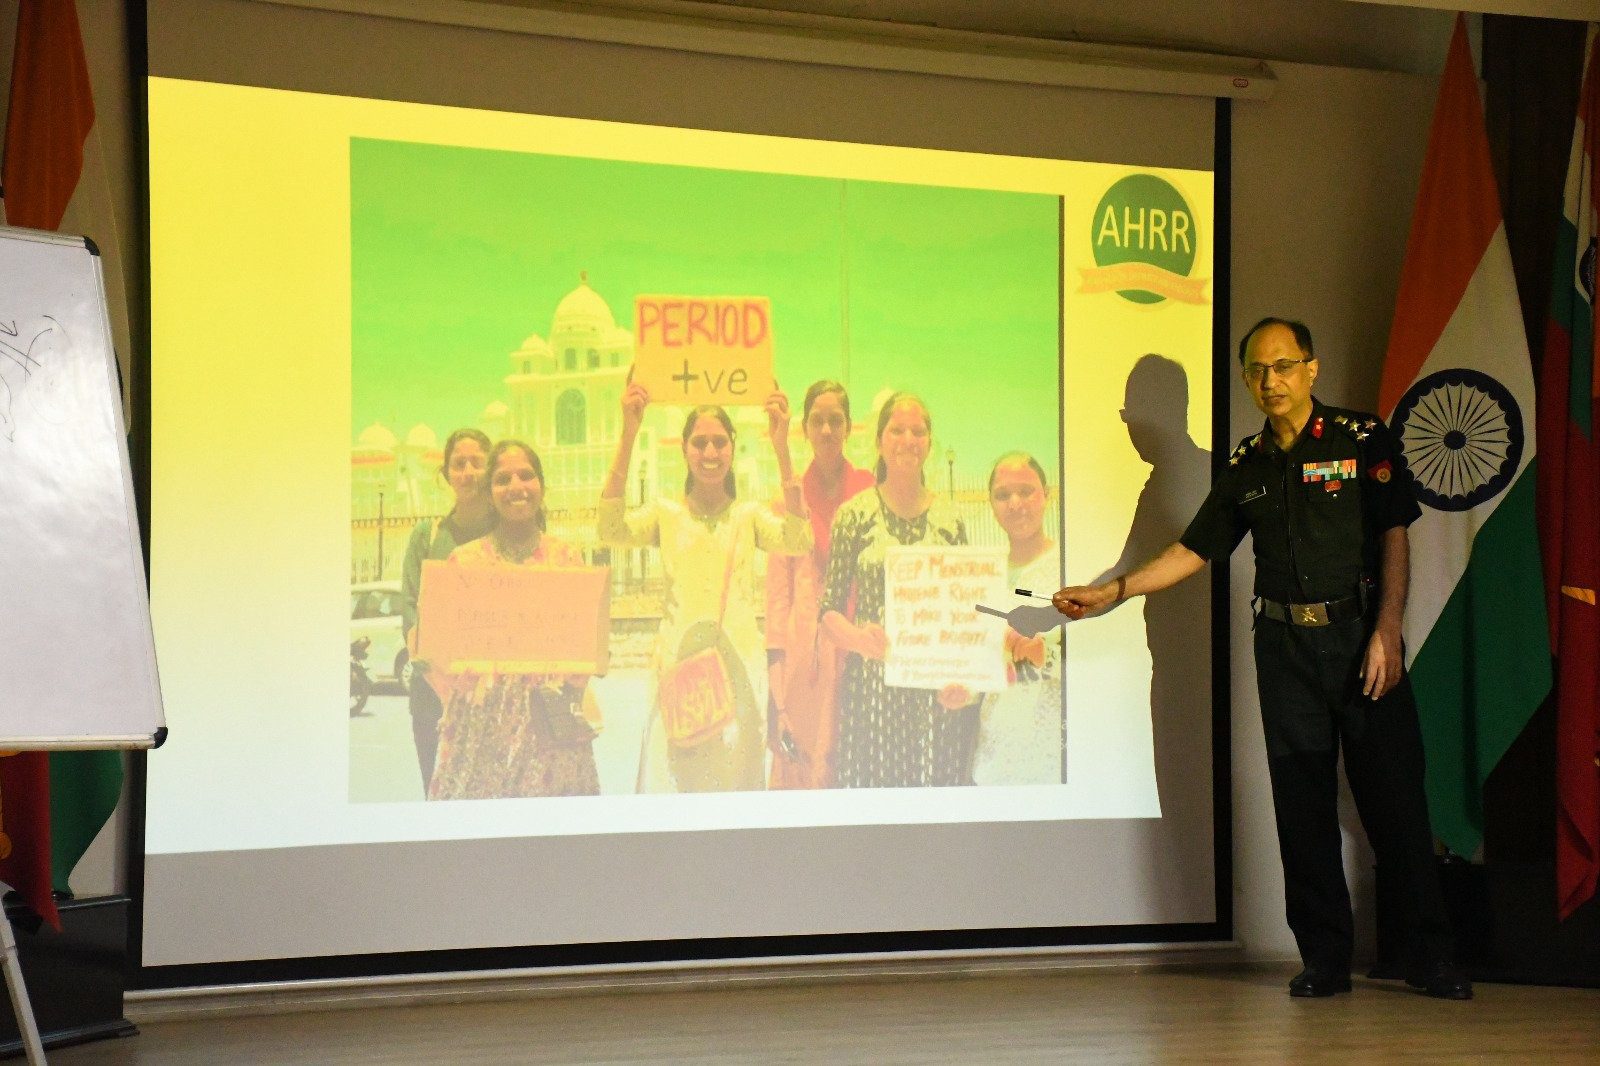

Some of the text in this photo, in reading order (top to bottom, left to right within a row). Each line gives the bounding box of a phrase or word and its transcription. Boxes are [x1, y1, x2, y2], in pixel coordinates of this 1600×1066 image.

[1097, 205, 1191, 254] AHRR
[639, 301, 768, 348] PERIOD
[672, 358, 748, 395] +ve
